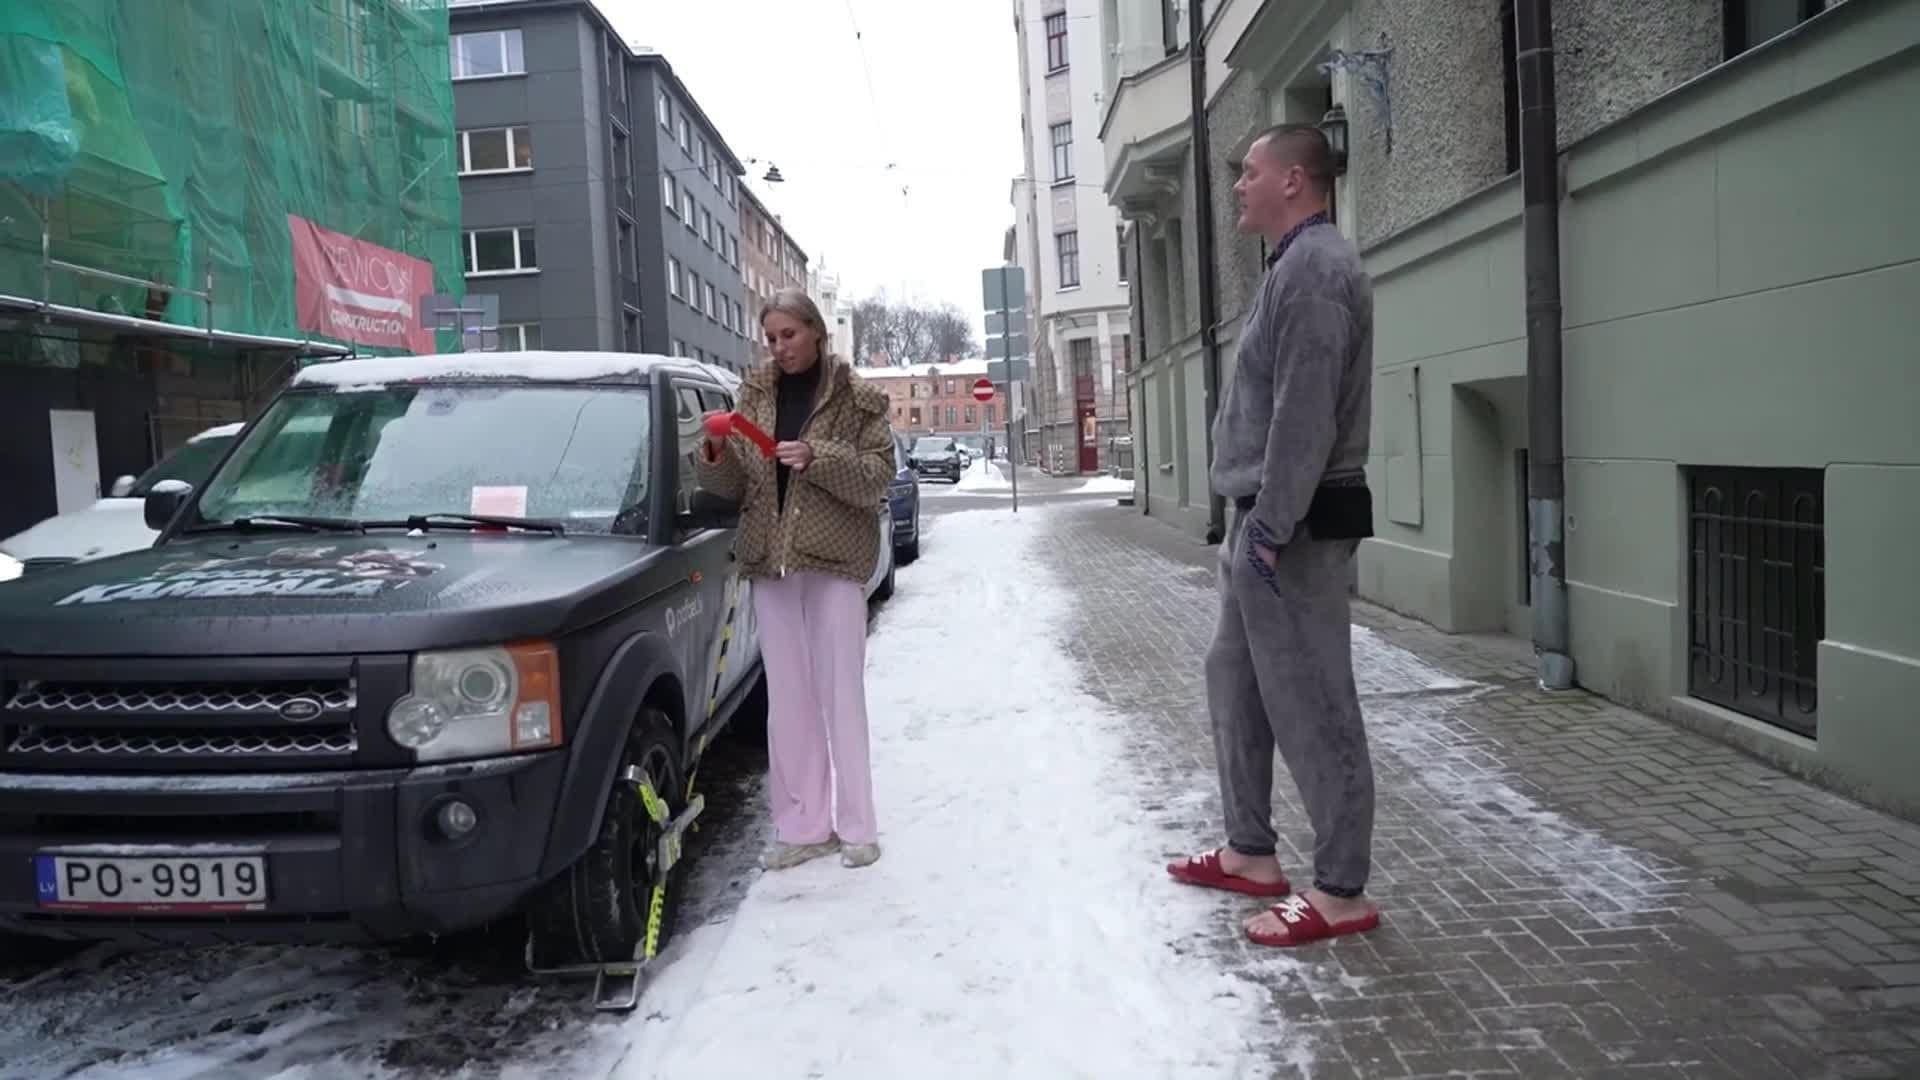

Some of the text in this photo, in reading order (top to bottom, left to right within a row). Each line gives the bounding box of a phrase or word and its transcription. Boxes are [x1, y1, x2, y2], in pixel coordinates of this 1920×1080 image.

[54, 577, 385, 606] KAMBALA
[39, 881, 55, 893] LV
[65, 861, 257, 897] PO-9919
